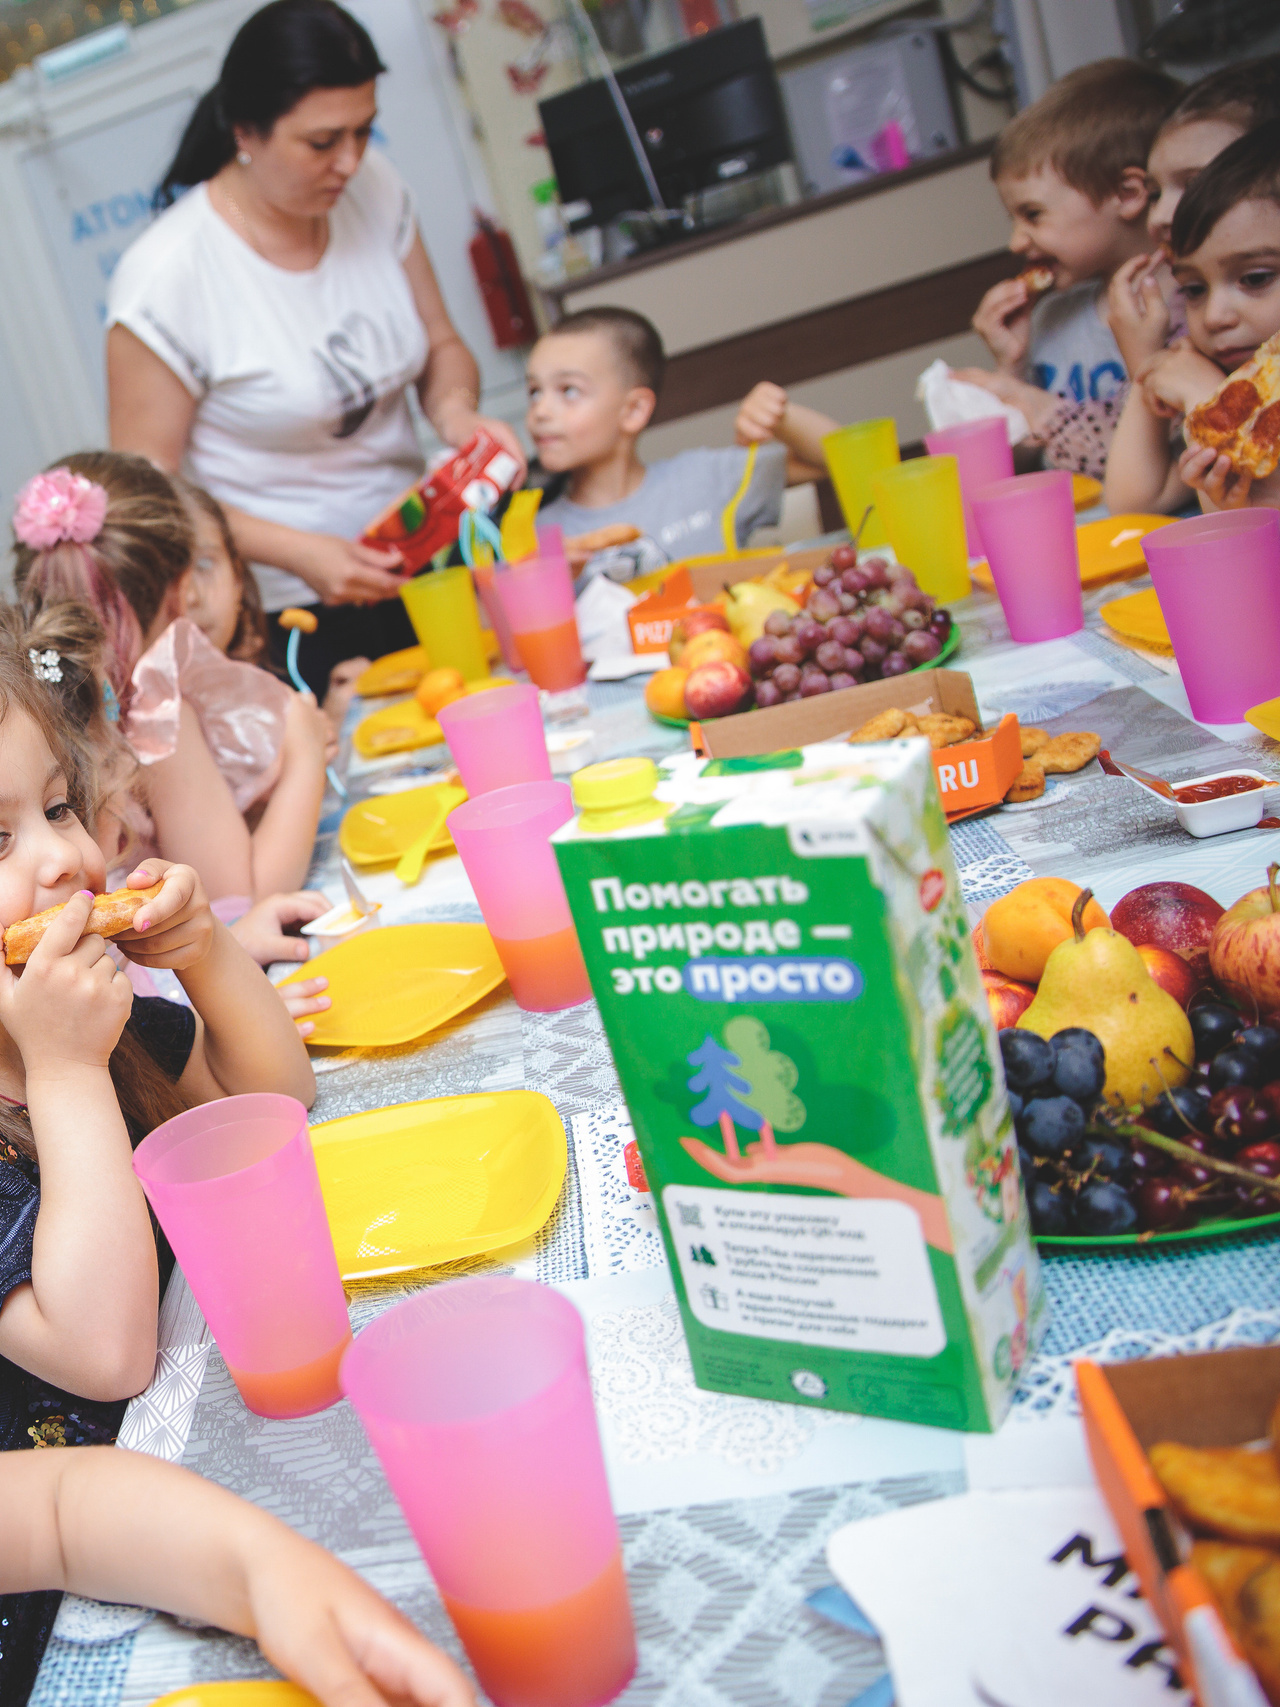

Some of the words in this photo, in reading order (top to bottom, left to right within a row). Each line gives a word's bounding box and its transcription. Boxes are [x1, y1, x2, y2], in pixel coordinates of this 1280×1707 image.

[634, 617, 681, 646] PIZZ
[590, 875, 810, 913] Помогать
[602, 919, 801, 960] природе
[611, 966, 683, 995] это
[689, 962, 856, 1002] просто
